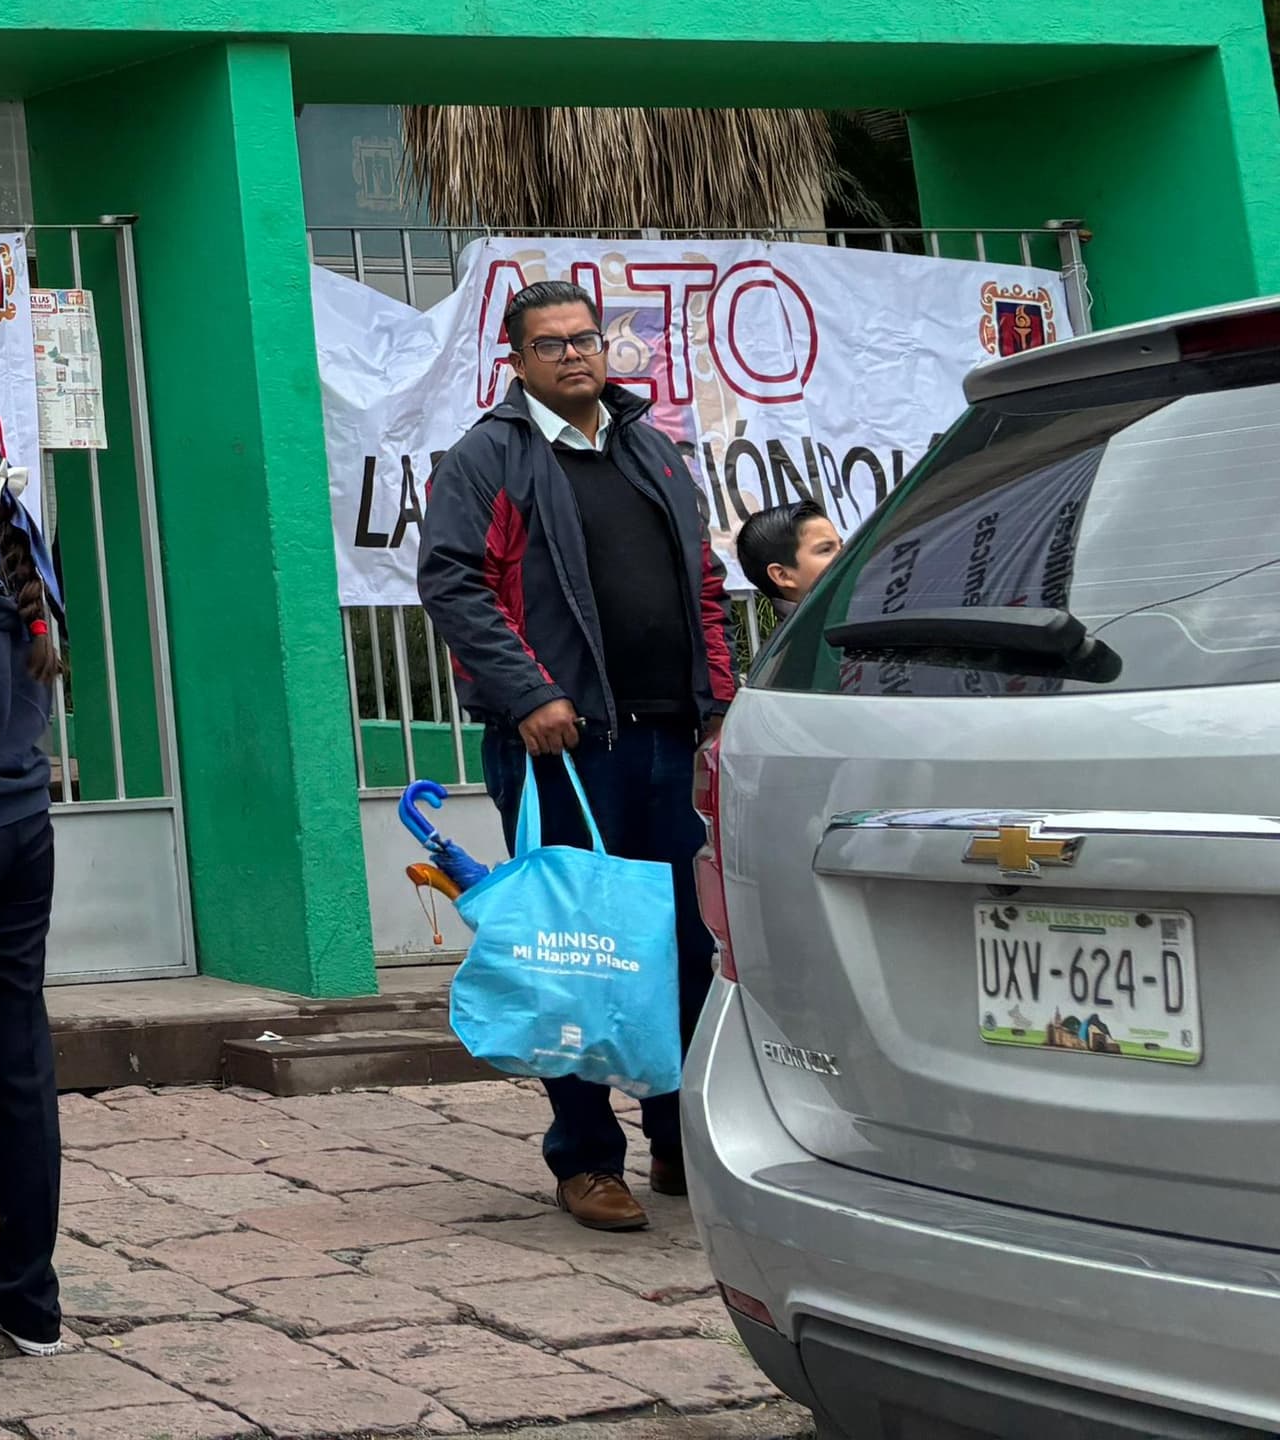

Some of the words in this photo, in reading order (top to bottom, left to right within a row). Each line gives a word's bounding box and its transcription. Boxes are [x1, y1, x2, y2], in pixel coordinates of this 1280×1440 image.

[476, 259, 818, 408] ALTO
[1026, 910, 1053, 924] SAN
[1056, 912, 1081, 925] LUIS
[537, 931, 616, 953] MINISO
[512, 945, 532, 959] Mi
[537, 947, 592, 965] Happy
[595, 953, 640, 972] Place
[980, 937, 1184, 1014] UXV-624-D
